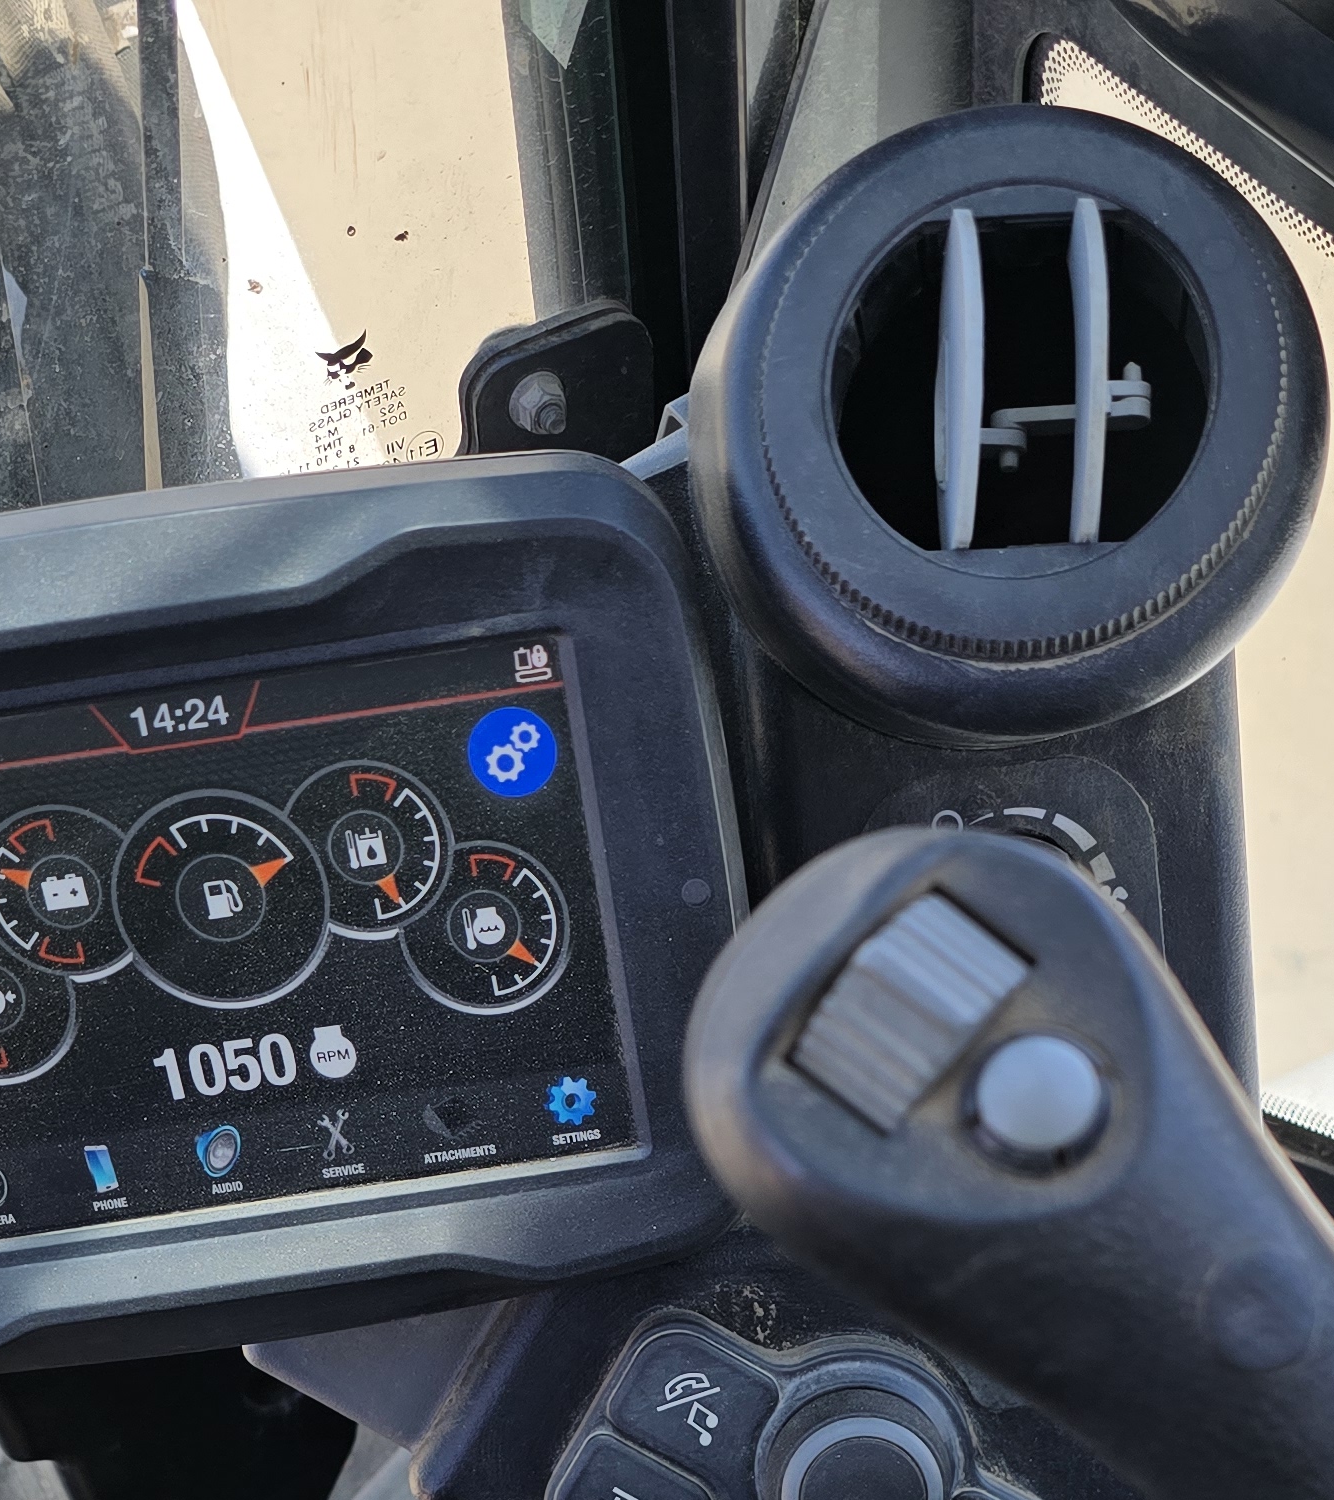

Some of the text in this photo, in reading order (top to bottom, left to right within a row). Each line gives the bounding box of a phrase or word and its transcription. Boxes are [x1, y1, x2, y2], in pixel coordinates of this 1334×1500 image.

[129, 694, 230, 737] 14:24
[316, 1048, 351, 1064] RPM
[152, 1032, 297, 1101] 1050
[551, 1128, 602, 1147] SETTINGS
[423, 1143, 497, 1165] ATTACHMENTS
[321, 1162, 366, 1179] SERVICE
[211, 1180, 244, 1195] AUDIO
[92, 1196, 129, 1212] PHONE
